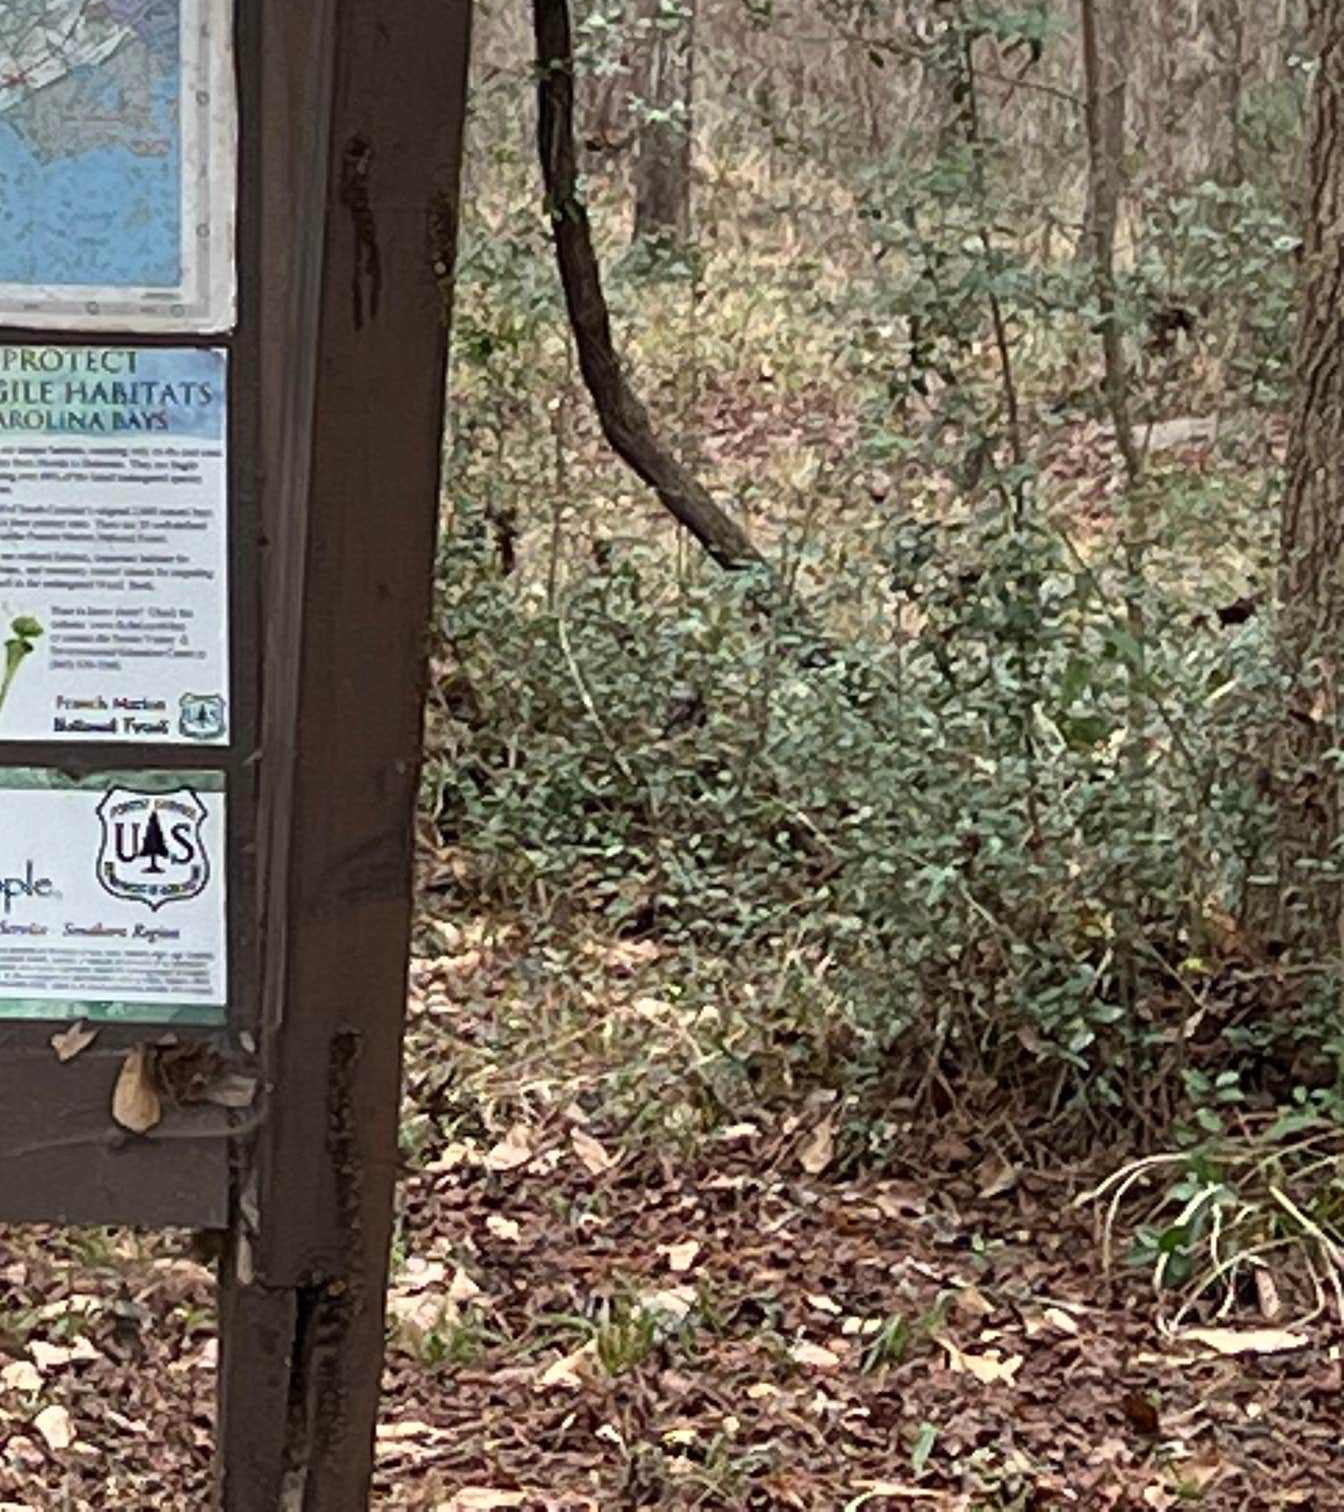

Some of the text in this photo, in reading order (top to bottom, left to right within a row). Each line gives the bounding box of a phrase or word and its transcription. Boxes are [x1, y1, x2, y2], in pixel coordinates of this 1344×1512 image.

[2, 347, 138, 373] PROTECT
[65, 381, 213, 406] HABITATS
[112, 409, 169, 431] BAYS
